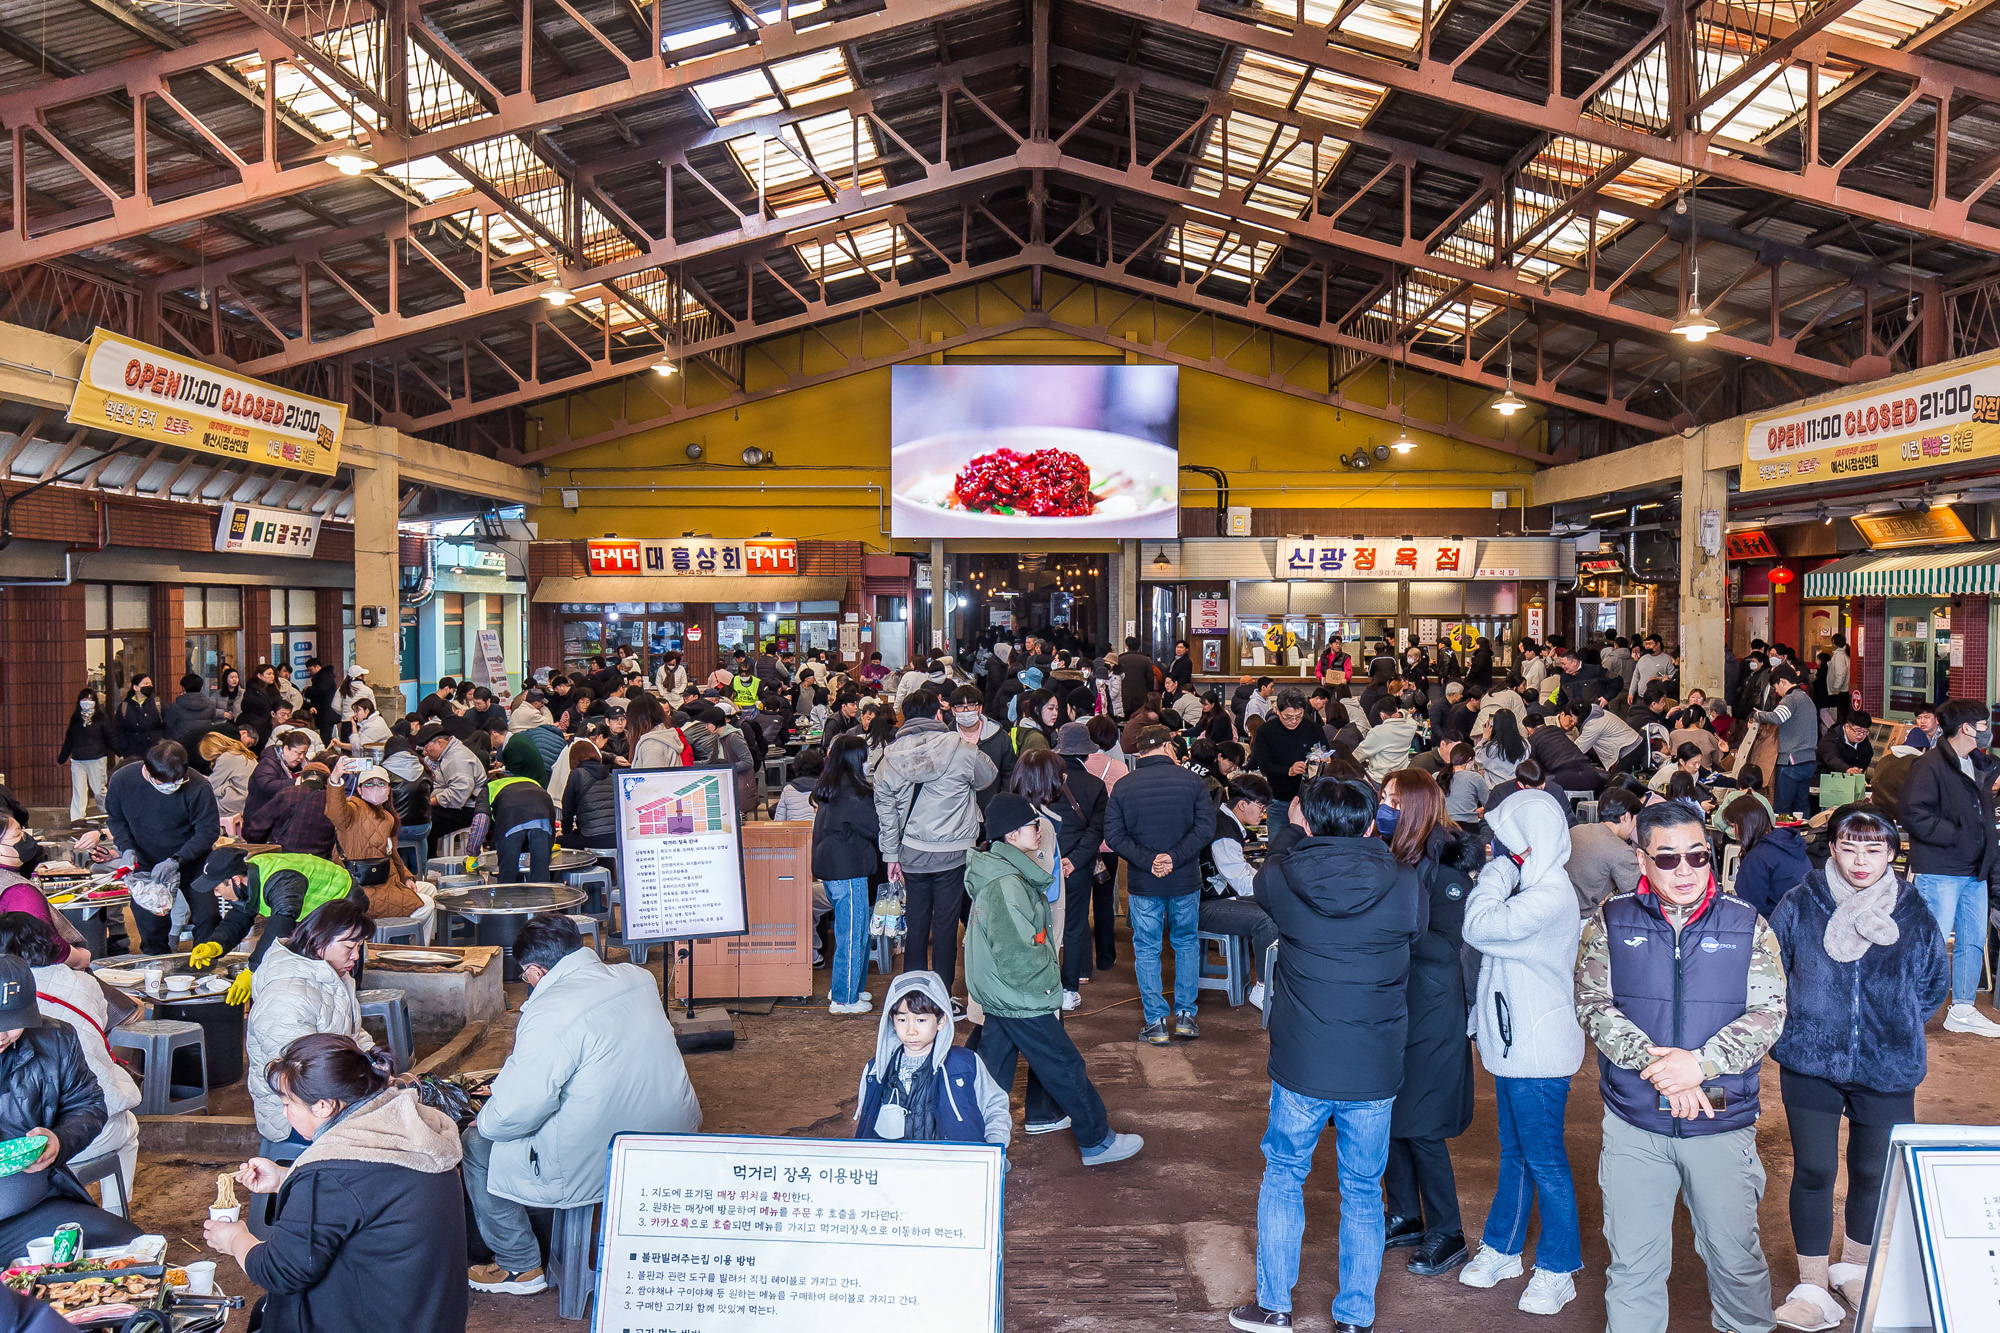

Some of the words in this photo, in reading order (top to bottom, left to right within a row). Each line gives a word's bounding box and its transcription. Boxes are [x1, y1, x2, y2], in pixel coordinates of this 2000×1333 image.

[125, 359, 182, 400] OPEN
[179, 374, 221, 409] 11:00
[221, 387, 284, 427] CLOSED
[283, 404, 320, 433] 21:00
[105, 400, 138, 425] 먹텐션
[138, 408, 159, 430] 유지
[1767, 421, 1806, 451] OPEN
[1806, 413, 1841, 443] 11:00
[1844, 398, 1918, 437] CLOSED
[1919, 384, 1972, 421] 21:00
[1972, 395, 2000, 424] 맛집
[203, 432, 249, 454] 예산시장상인회
[317, 423, 335, 452] 맛집
[1901, 439, 1920, 461] 이런
[1922, 433, 1951, 458] 먹방은
[1953, 430, 1974, 453] 처음
[266, 439, 282, 459] 이런
[1831, 454, 1879, 474] 예산시장상인회
[591, 548, 640, 568] 다시다
[746, 548, 797, 568] 다시다
[1200, 600, 1219, 628] 정육점
[733, 1165, 777, 1182] 먹거리
[783, 1166, 812, 1183] 장옥
[819, 1167, 879, 1186] 이용방법
[641, 1188, 648, 1197] 1.
[651, 1188, 681, 1198] 지도에
[684, 1188, 713, 1199] 표기된
[716, 1190, 736, 1201] 매장
[739, 1191, 769, 1202] 위치를
[772, 1191, 813, 1203] 확인한다.
[639, 1203, 648, 1212] 2.
[652, 1203, 682, 1213] 원하는
[685, 1203, 714, 1214] 매장에
[717, 1205, 756, 1216] 방문하여
[759, 1206, 787, 1217] 메뉴를
[791, 1207, 811, 1218] 주문
[815, 1208, 824, 1218] 후
[828, 1209, 857, 1219] 호출을
[861, 1210, 902, 1221] 기다린다.
[638, 1218, 647, 1227] 3.
[650, 1218, 709, 1229] 카카오톡으로
[712, 1219, 751, 1231] 호출되면
[754, 1221, 783, 1232] 메뉴를
[787, 1222, 816, 1233] 가지고
[820, 1223, 888, 1236] 먹거리장옥으로
[891, 1226, 931, 1237] 이동하여
[934, 1227, 966, 1239] 먹는다.
[641, 1252, 710, 1265] 불판빌려주는집
[713, 1253, 733, 1266] 이용
[736, 1254, 756, 1267] 방법
[626, 1271, 634, 1280] 1.
[637, 1270, 665, 1281] 불판과
[668, 1271, 686, 1282] 관련
[689, 1272, 715, 1283] 도구를
[719, 1273, 747, 1284] 빌려서
[750, 1274, 768, 1285] 직접
[771, 1275, 806, 1286] 테이블로
[810, 1276, 837, 1287] 가지고
[840, 1277, 862, 1288] 간다.
[625, 1286, 634, 1295] 2.
[637, 1286, 674, 1296] 쌈야채나
[677, 1287, 713, 1298] 구이야채
[716, 1288, 725, 1298] 등
[728, 1288, 756, 1300] 원하는
[759, 1290, 786, 1301] 메뉴를
[789, 1291, 826, 1302] 구매하여
[829, 1292, 865, 1304] 테이블로
[869, 1294, 896, 1304] 가지고
[899, 1295, 920, 1306] 간다.
[623, 1301, 632, 1310] 3.
[635, 1301, 663, 1312] 구매한
[665, 1302, 694, 1313] 고기와
[696, 1303, 715, 1314] 함께
[718, 1303, 746, 1314] 맛있게
[748, 1304, 778, 1316] 먹는다.
